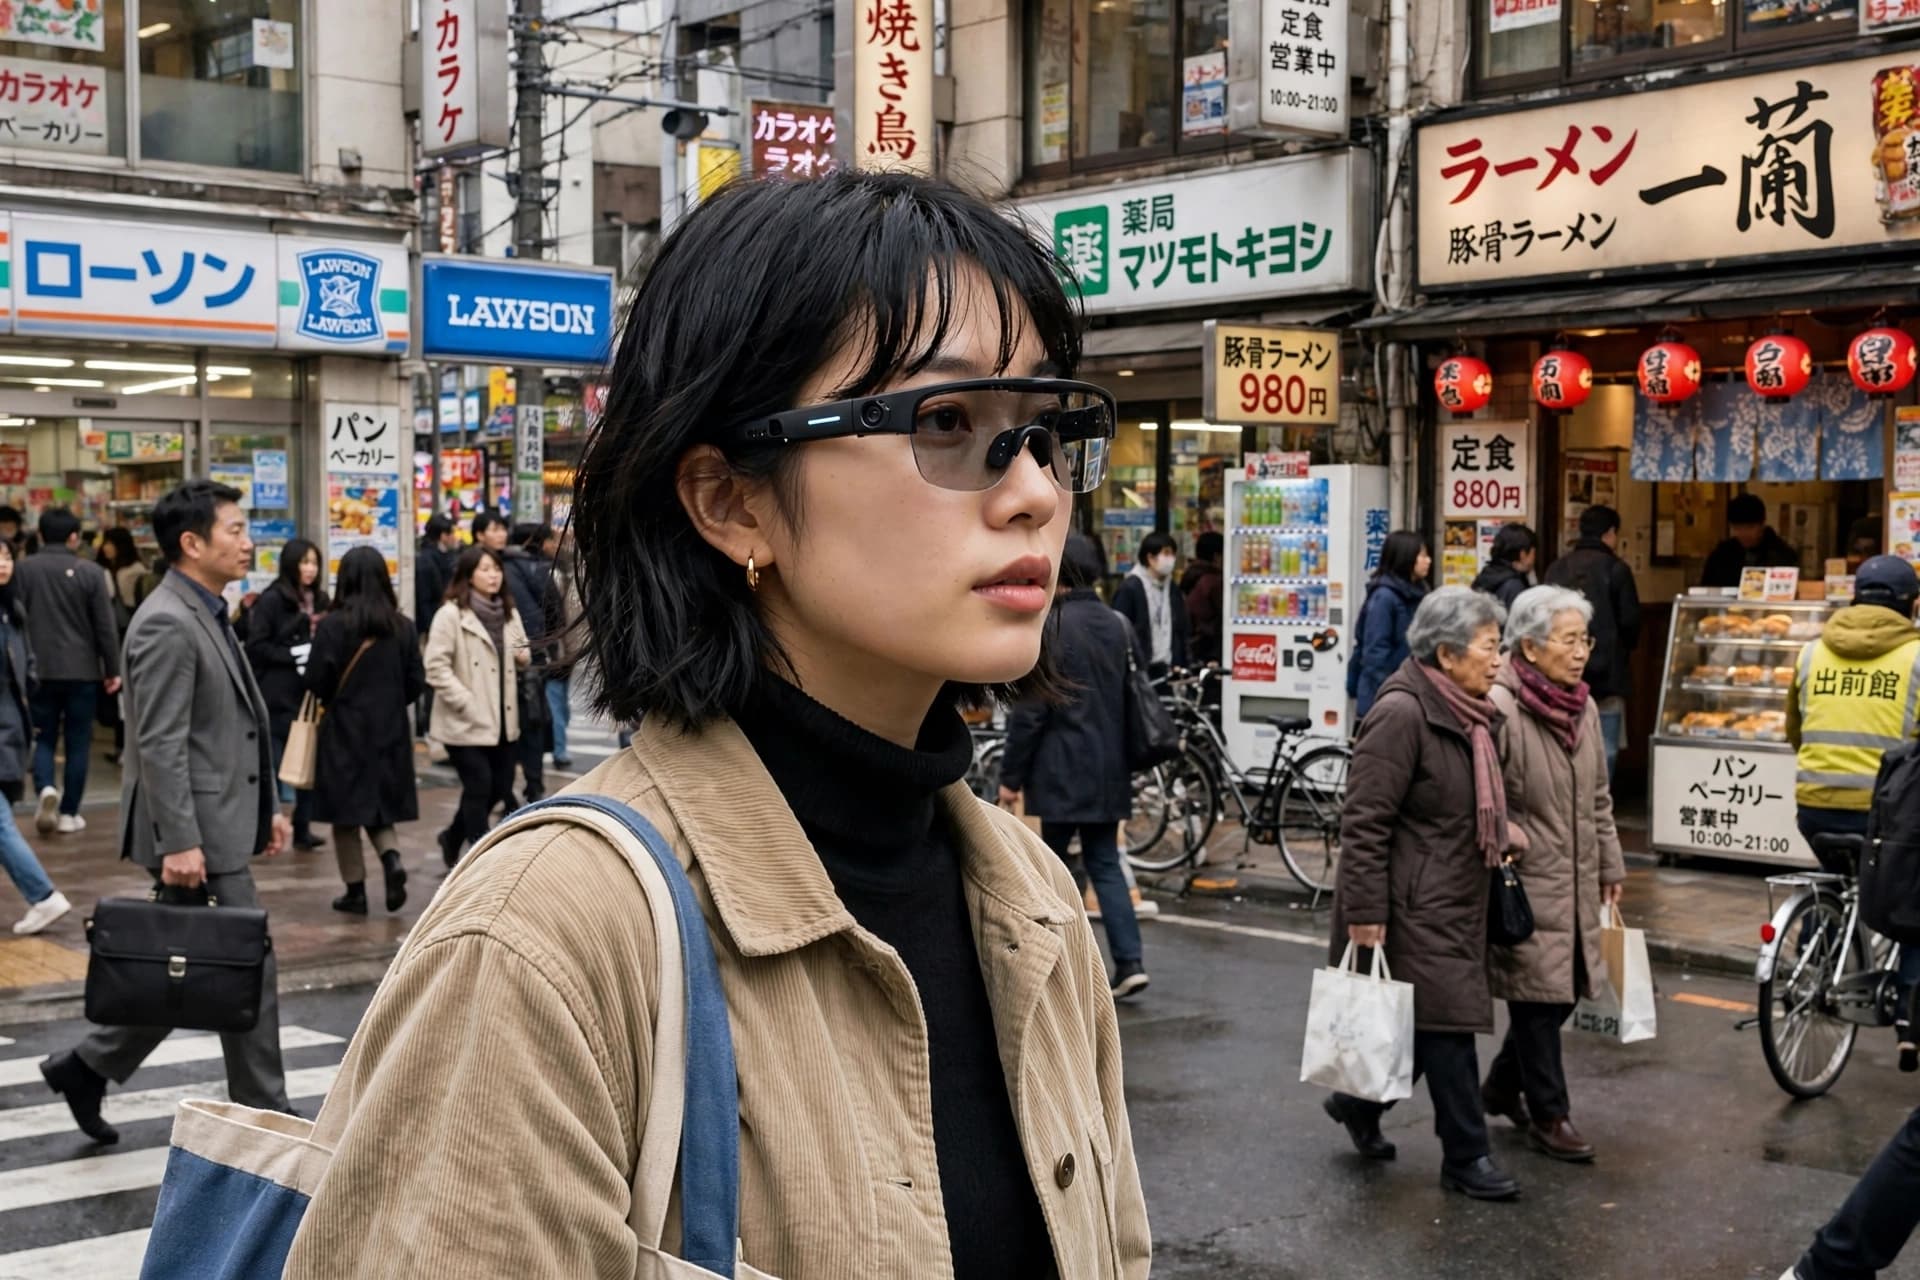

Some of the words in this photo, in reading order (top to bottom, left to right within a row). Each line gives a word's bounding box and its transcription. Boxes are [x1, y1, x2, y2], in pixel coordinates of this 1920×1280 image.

[1281, 8, 1323, 41] 定食
[436, 0, 463, 143] カラケ
[1270, 41, 1336, 77] 営業中
[0, 69, 99, 109] カラオケ
[866, 0, 922, 160] 焼き鳥
[1440, 123, 1638, 205] ラーメン
[1121, 194, 1175, 236] 薬局
[1061, 223, 1103, 285] 薬
[1119, 221, 1333, 290] マツモトキヨシ
[1447, 212, 1618, 265] 豚骨ラーメン
[25, 240, 256, 308] ローソン
[305, 258, 373, 280] LAWSON
[306, 312, 373, 335] LAWSON
[447, 294, 596, 335] LAWSON
[1223, 335, 1332, 371] 豚骨ラーメン
[1240, 373, 1328, 416] 980円
[331, 411, 388, 443] パン
[330, 448, 395, 466] ベーカリー
[1451, 434, 1517, 472] 定食
[1453, 480, 1521, 510] 880円
[1812, 668, 1901, 701] 出前館
[1712, 754, 1757, 780] パン
[1688, 783, 1783, 807] ベーカリー
[1678, 806, 1739, 831] 営業中
